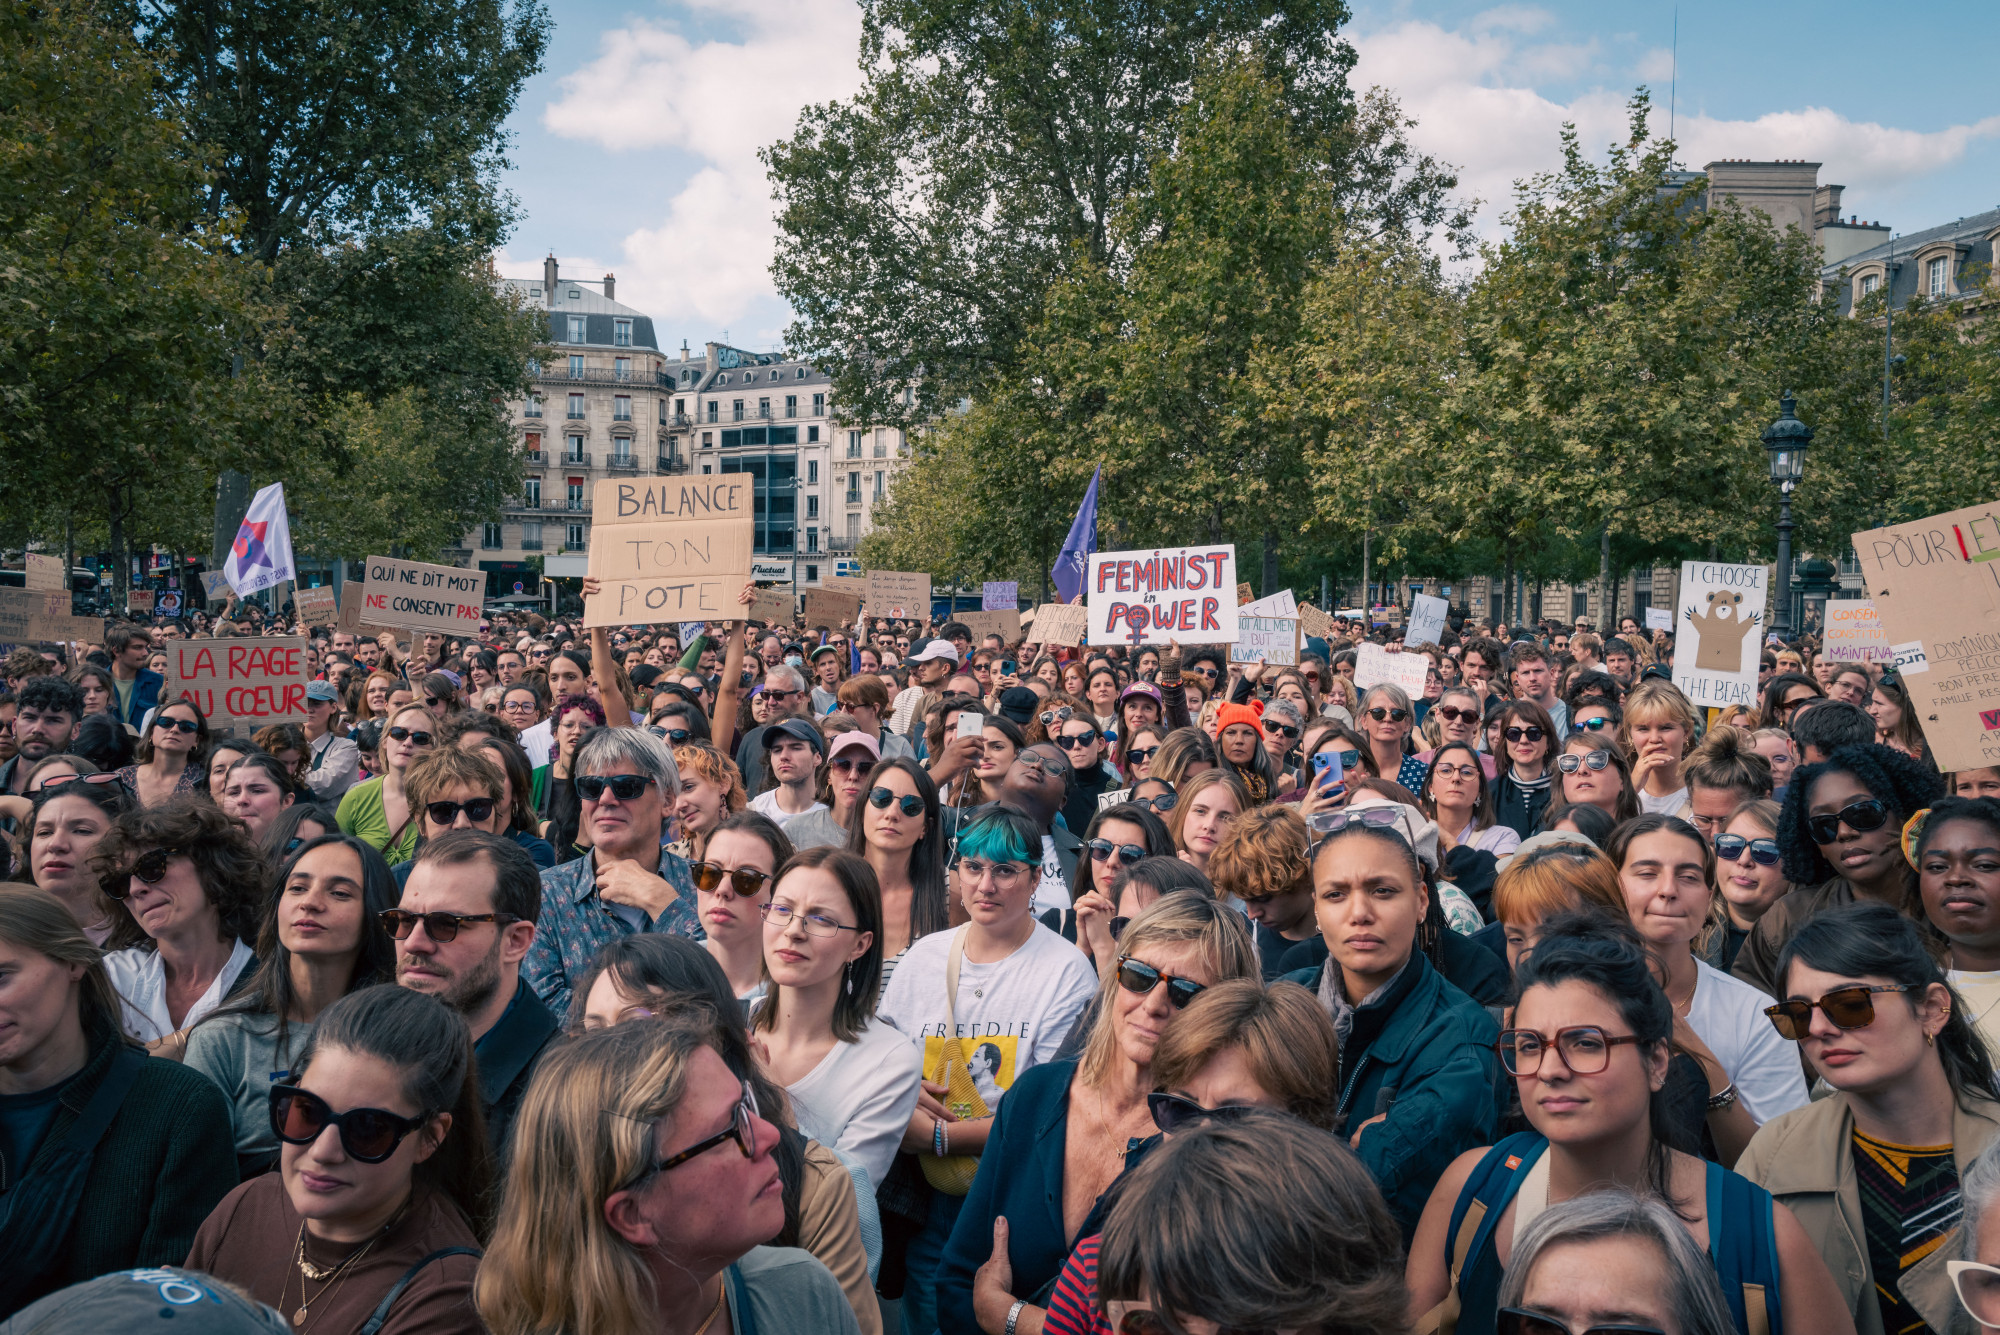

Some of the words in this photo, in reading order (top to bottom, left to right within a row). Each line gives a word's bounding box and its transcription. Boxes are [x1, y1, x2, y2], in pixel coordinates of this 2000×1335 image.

[618, 484, 742, 518] BALANCE
[626, 536, 711, 570] TON
[372, 564, 396, 582] QUI
[400, 570, 418, 584] NE
[422, 571, 444, 587] DIT
[448, 576, 478, 592] MOT
[1097, 550, 1229, 593] FEMINIST
[1691, 564, 1695, 582] I
[1702, 566, 1762, 588] CHOOSE
[366, 594, 388, 609] NE
[393, 596, 455, 616] CONSENT
[456, 604, 480, 620] PAS
[619, 582, 722, 616] POTE
[1144, 592, 1156, 603] in
[1105, 597, 1220, 640] POWER
[1253, 618, 1272, 632] ALL
[1274, 619, 1294, 632] MEN
[1251, 632, 1274, 645] BUT
[1830, 644, 1893, 660] MAINTENA
[180, 648, 216, 680] LA
[228, 646, 301, 679] RAGE
[1232, 648, 1264, 661] ALWAYS
[225, 684, 308, 716] CŒUR
[1681, 676, 1710, 698] THE
[1714, 680, 1757, 710] BEAR
